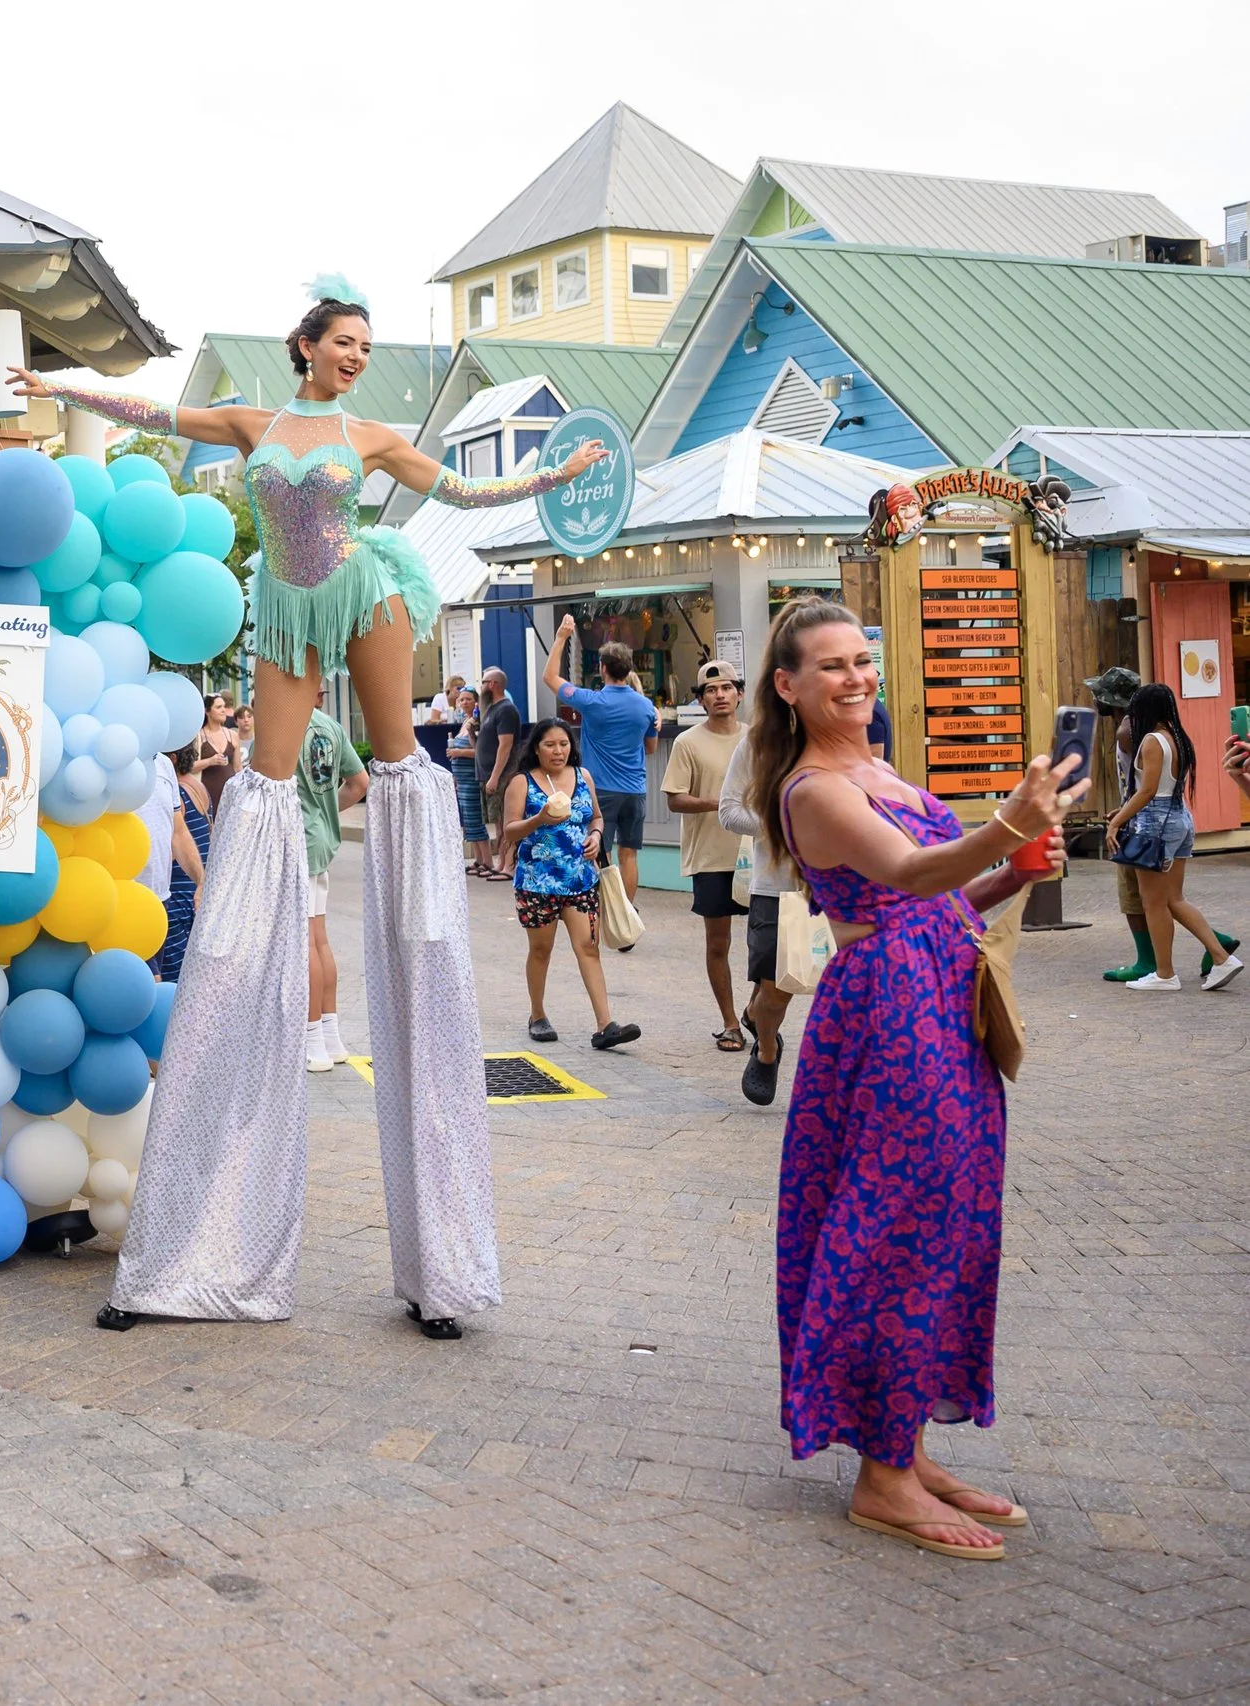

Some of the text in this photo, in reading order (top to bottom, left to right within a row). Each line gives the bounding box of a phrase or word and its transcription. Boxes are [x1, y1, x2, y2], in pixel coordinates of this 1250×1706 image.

[979, 471, 1027, 504] ALLEY
[561, 478, 614, 507] Siren
[976, 575, 997, 583] CRUISES
[924, 605, 941, 613] DESTIN
[1000, 604, 1016, 612] TOURS
[946, 664, 968, 672] TROPICS
[969, 663, 982, 671] GIFTS
[989, 663, 1010, 671] JEWELRY
[963, 692, 974, 700] TIME
[943, 722, 961, 730] DESTIN
[961, 750, 977, 758] GLASS
[978, 750, 998, 758] BOTTOM
